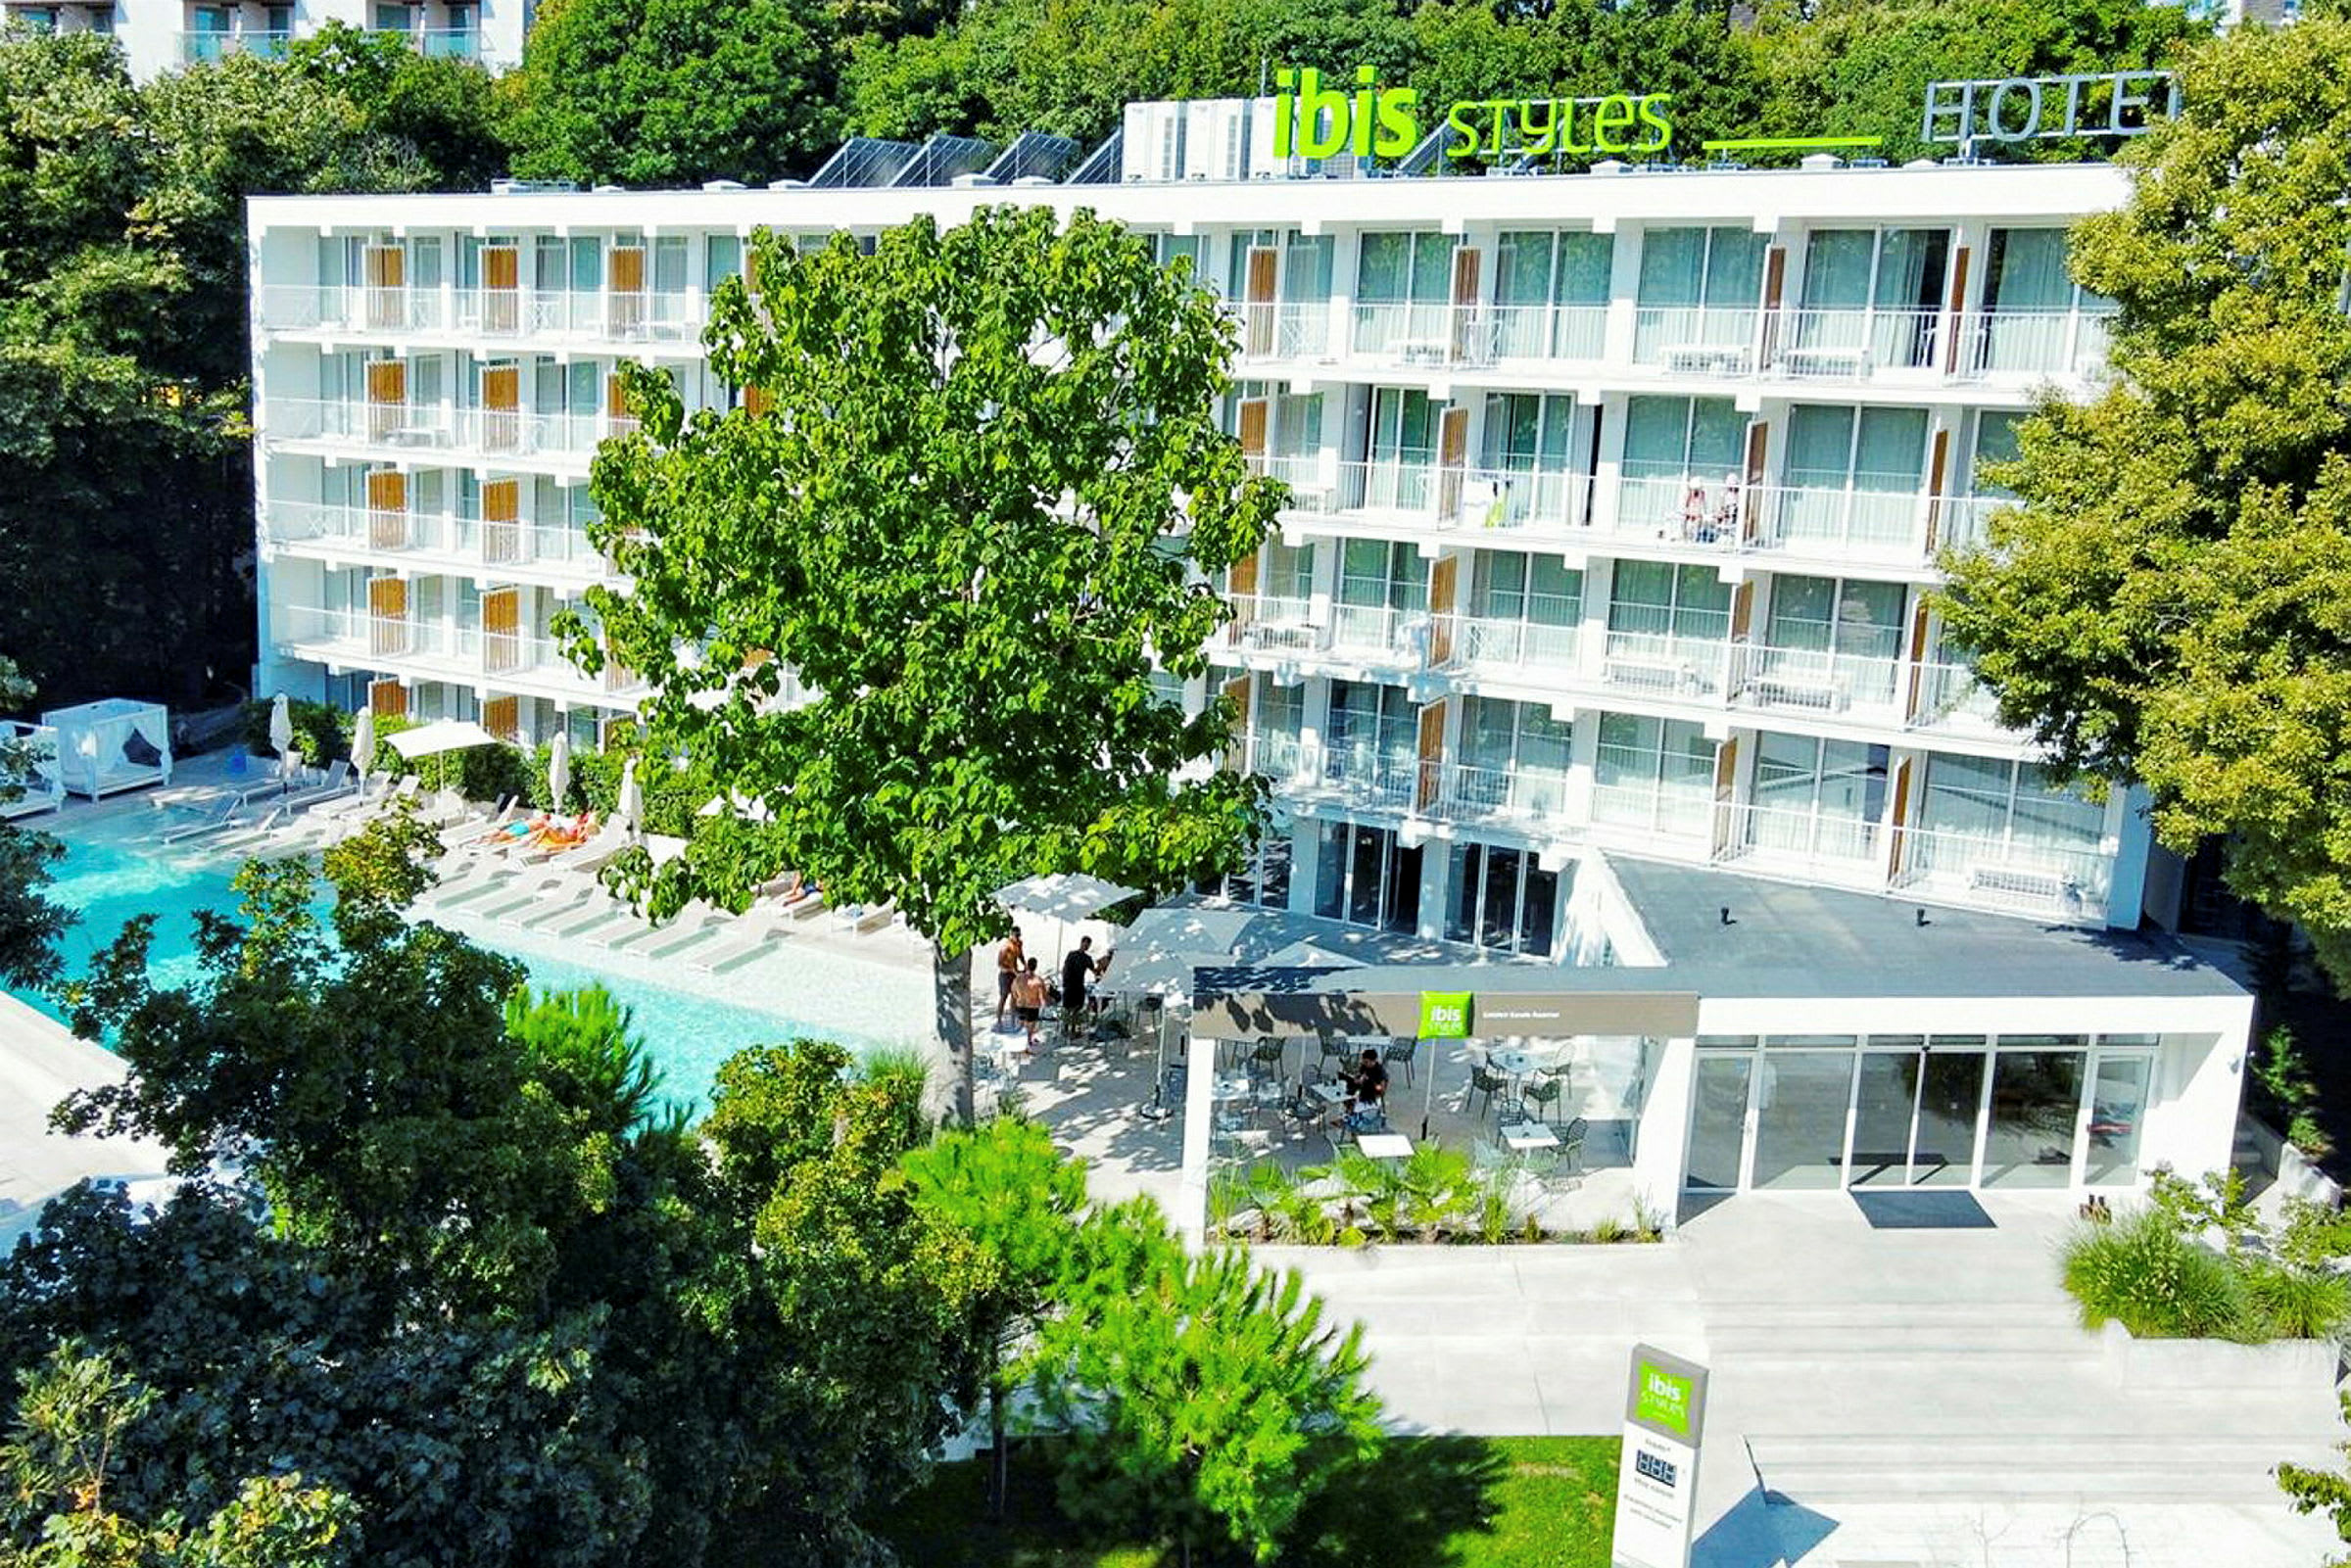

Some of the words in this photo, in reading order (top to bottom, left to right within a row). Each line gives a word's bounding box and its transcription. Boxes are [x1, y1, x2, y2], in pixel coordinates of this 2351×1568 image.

[1273, 66, 1417, 158] ibis
[1430, 1005, 1461, 1022] ibis
[1648, 1373, 1681, 1402] ibis
